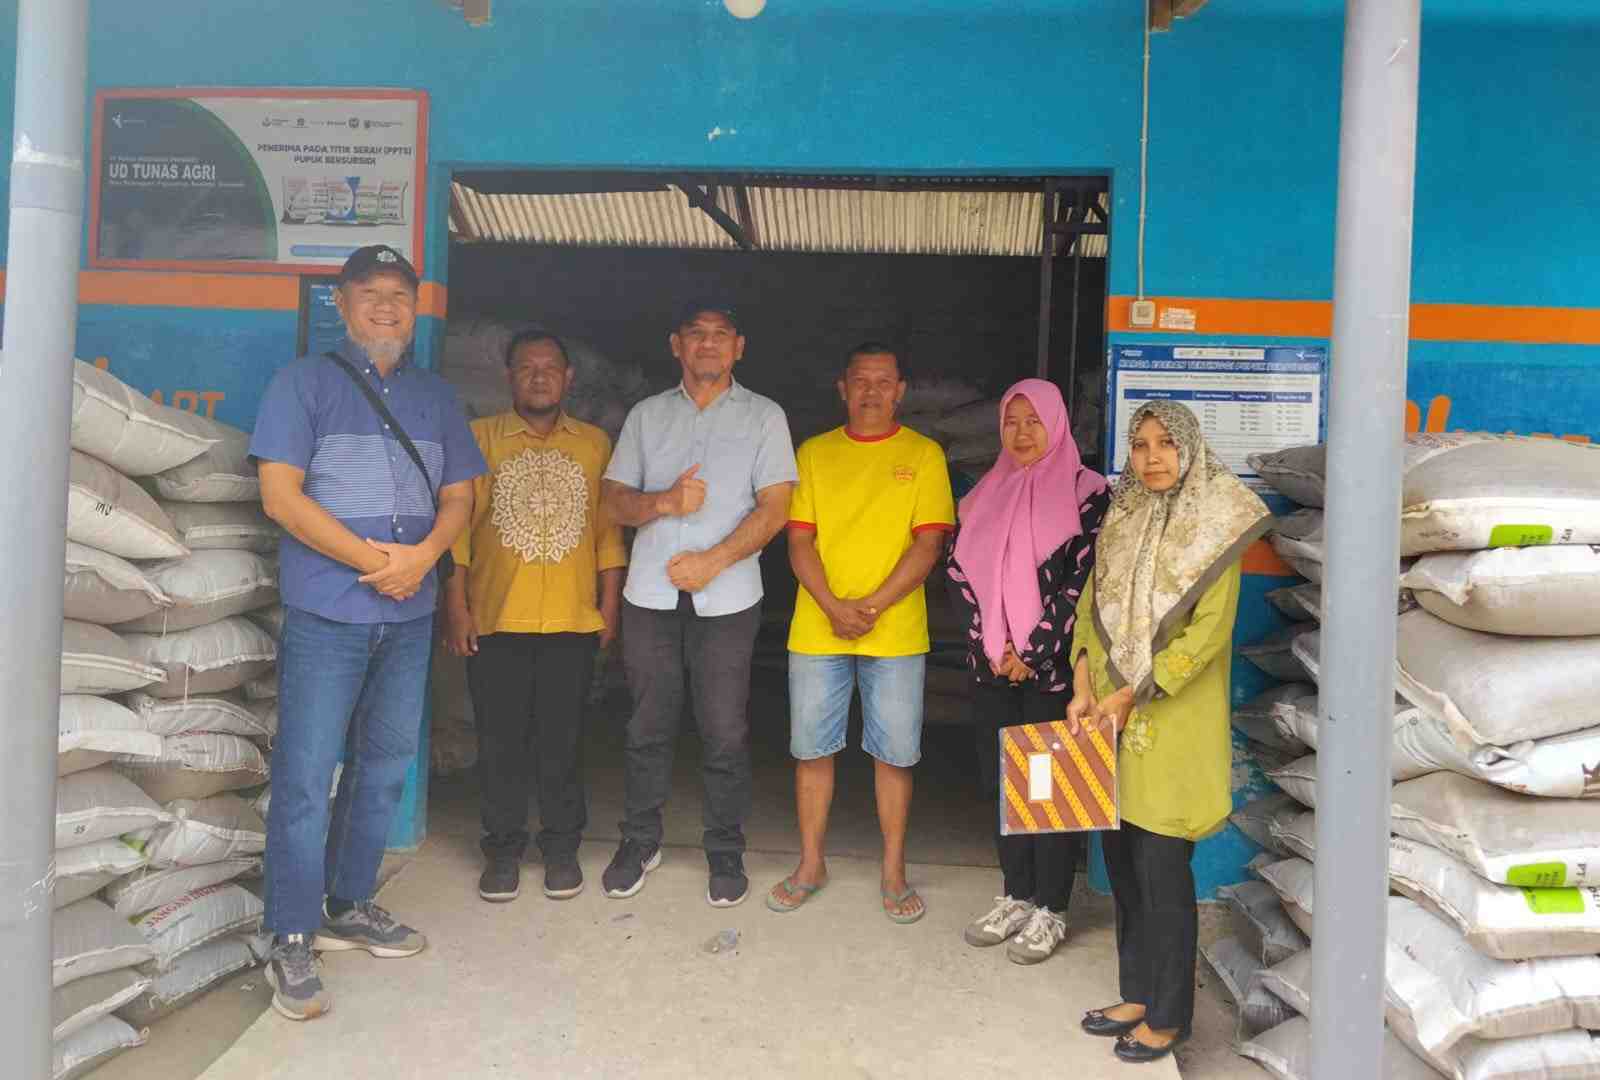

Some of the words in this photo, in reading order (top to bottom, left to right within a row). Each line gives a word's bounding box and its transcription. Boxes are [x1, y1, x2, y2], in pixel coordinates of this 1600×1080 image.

[303, 145, 328, 153] PADA
[109, 163, 128, 178] UD
[131, 163, 178, 179] TUNAS
[182, 164, 216, 180] AGRI
